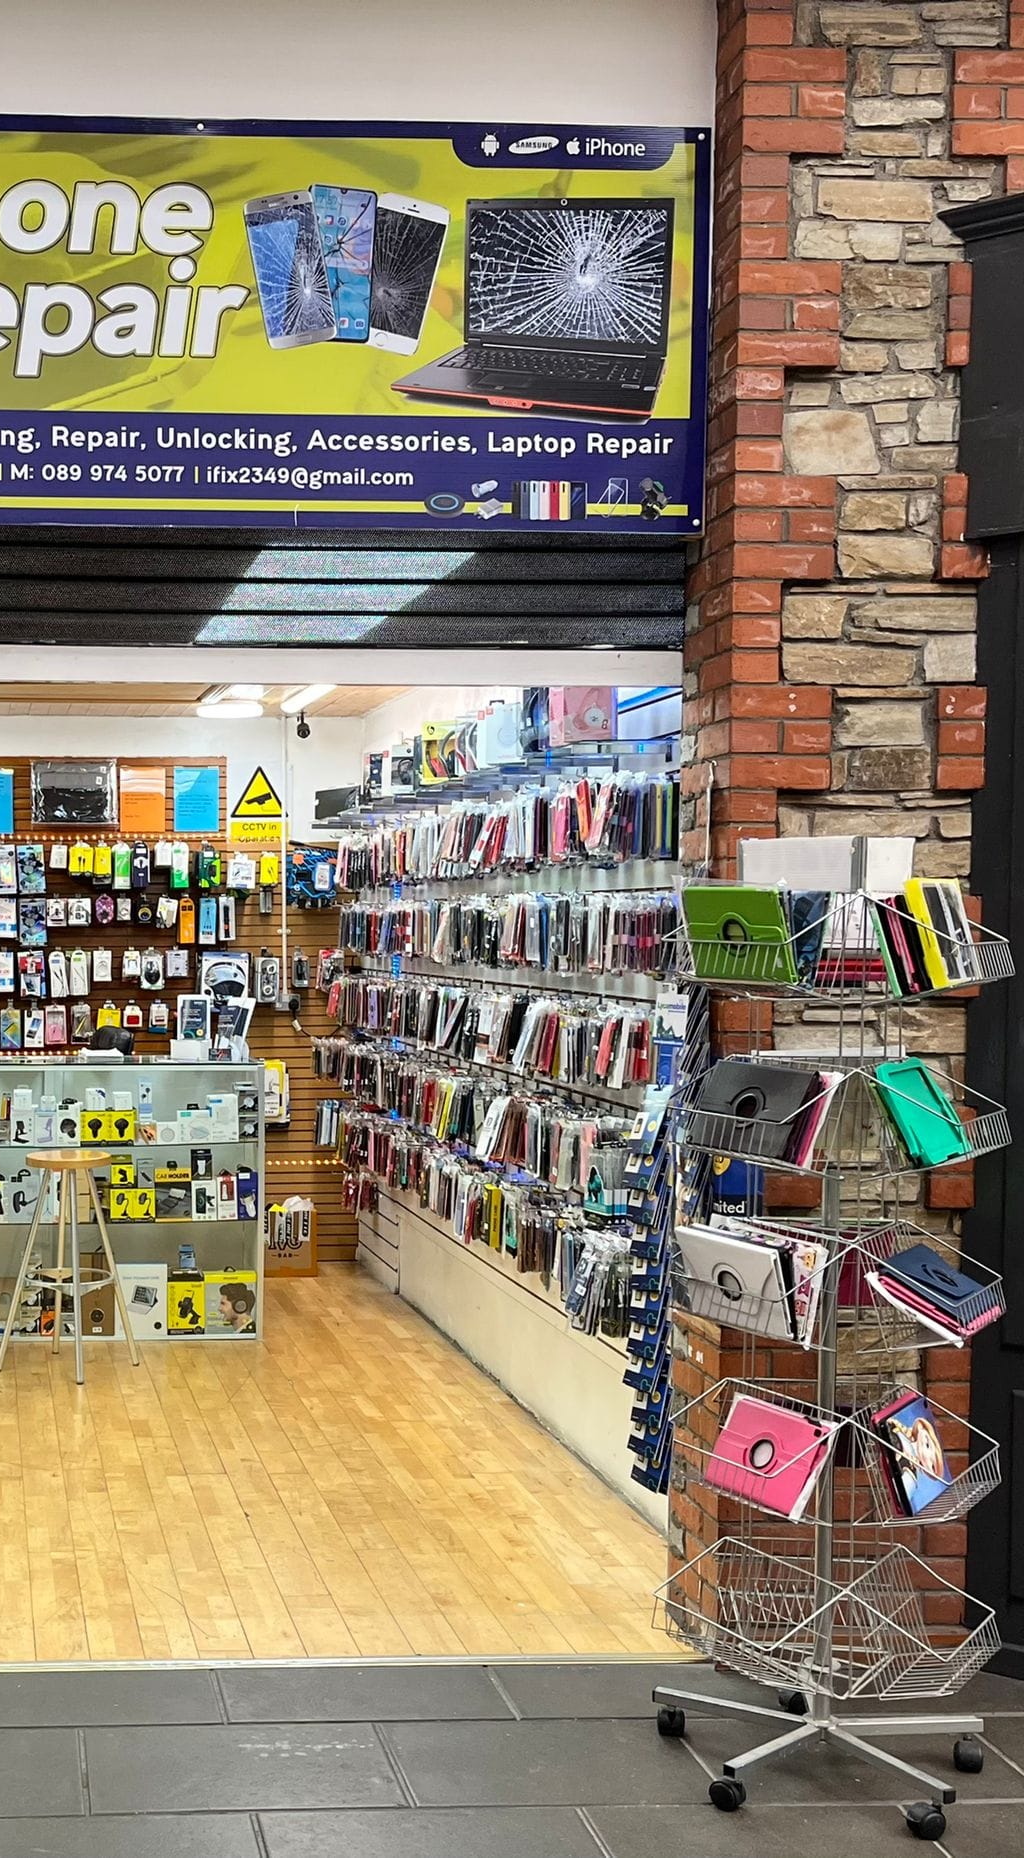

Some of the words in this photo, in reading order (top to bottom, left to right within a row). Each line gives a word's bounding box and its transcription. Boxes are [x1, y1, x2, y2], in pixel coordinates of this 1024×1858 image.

[514, 141, 553, 149] SAMSUNG
[585, 138, 646, 156] iPhone
[51, 425, 147, 453] Repair,
[156, 427, 298, 457] Unlocking,
[307, 429, 477, 455] Accessories,
[488, 432, 576, 457] Laptop
[587, 432, 674, 458] Repair
[10, 464, 34, 481] M:
[41, 464, 82, 481] 089
[90, 465, 128, 482] 974
[135, 465, 185, 483] 5077
[206, 466, 414, 489] ifix2349@gmail.com
[242, 823, 266, 831] CCTV
